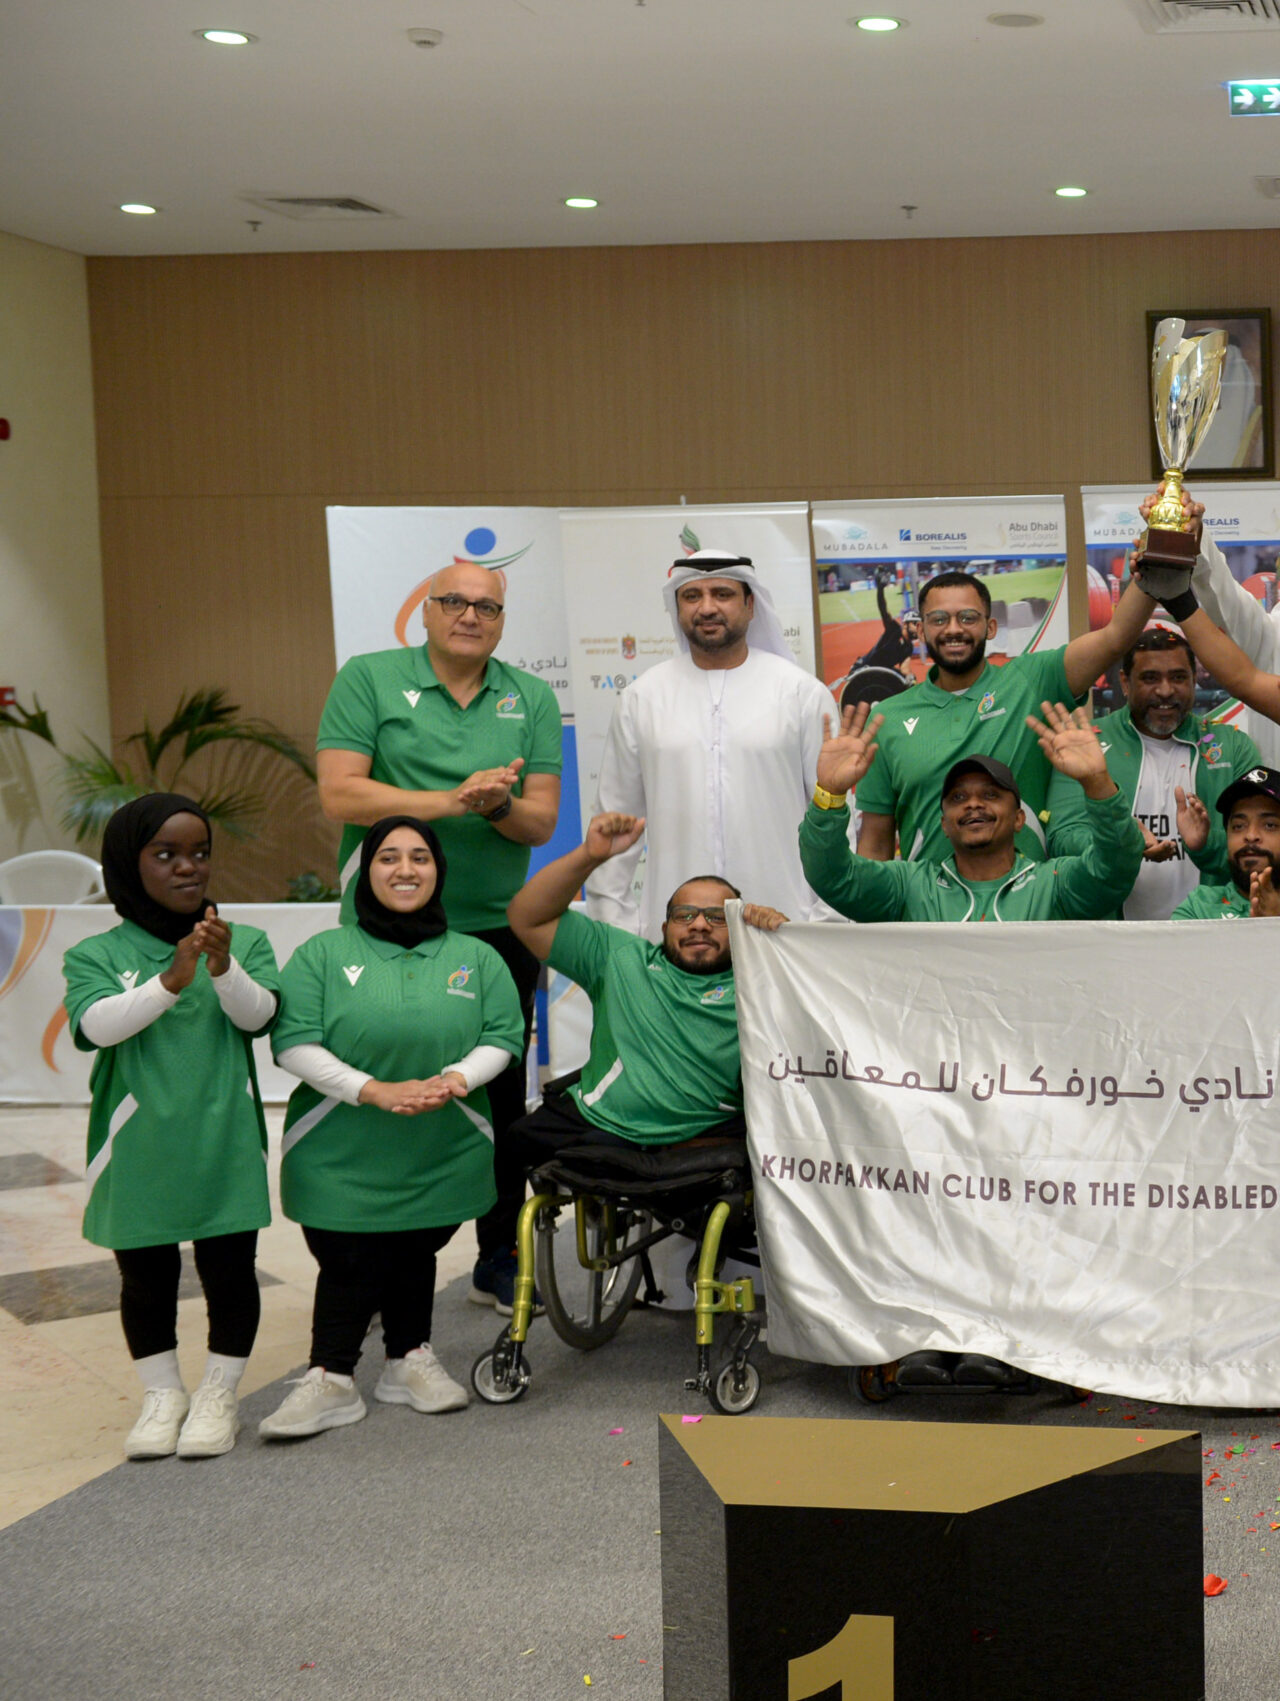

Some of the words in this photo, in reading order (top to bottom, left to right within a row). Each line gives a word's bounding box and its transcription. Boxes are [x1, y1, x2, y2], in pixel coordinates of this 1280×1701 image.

[1009, 522, 1028, 532] Abu
[1030, 521, 1059, 531] Dhabi
[1202, 517, 1240, 526] REALIS
[915, 532, 968, 541] BOREALIS
[1093, 528, 1142, 537] MUBAD
[823, 543, 889, 552] MUBADALA
[783, 627, 800, 637] abi
[590, 673, 637, 689] TAQ
[1134, 814, 1170, 837] TED
[768, 1049, 959, 1093] للمعاقين
[971, 1064, 1165, 1106] خورفكان
[1179, 1066, 1275, 1112] نادي
[761, 1154, 930, 1196] KHORFAKKAN
[942, 1173, 1013, 1203] CLUB
[1024, 1180, 1077, 1206] FOR
[1088, 1182, 1136, 1208] THE
[1147, 1183, 1279, 1210] DISABLED
[788, 1613, 894, 1701] 1
